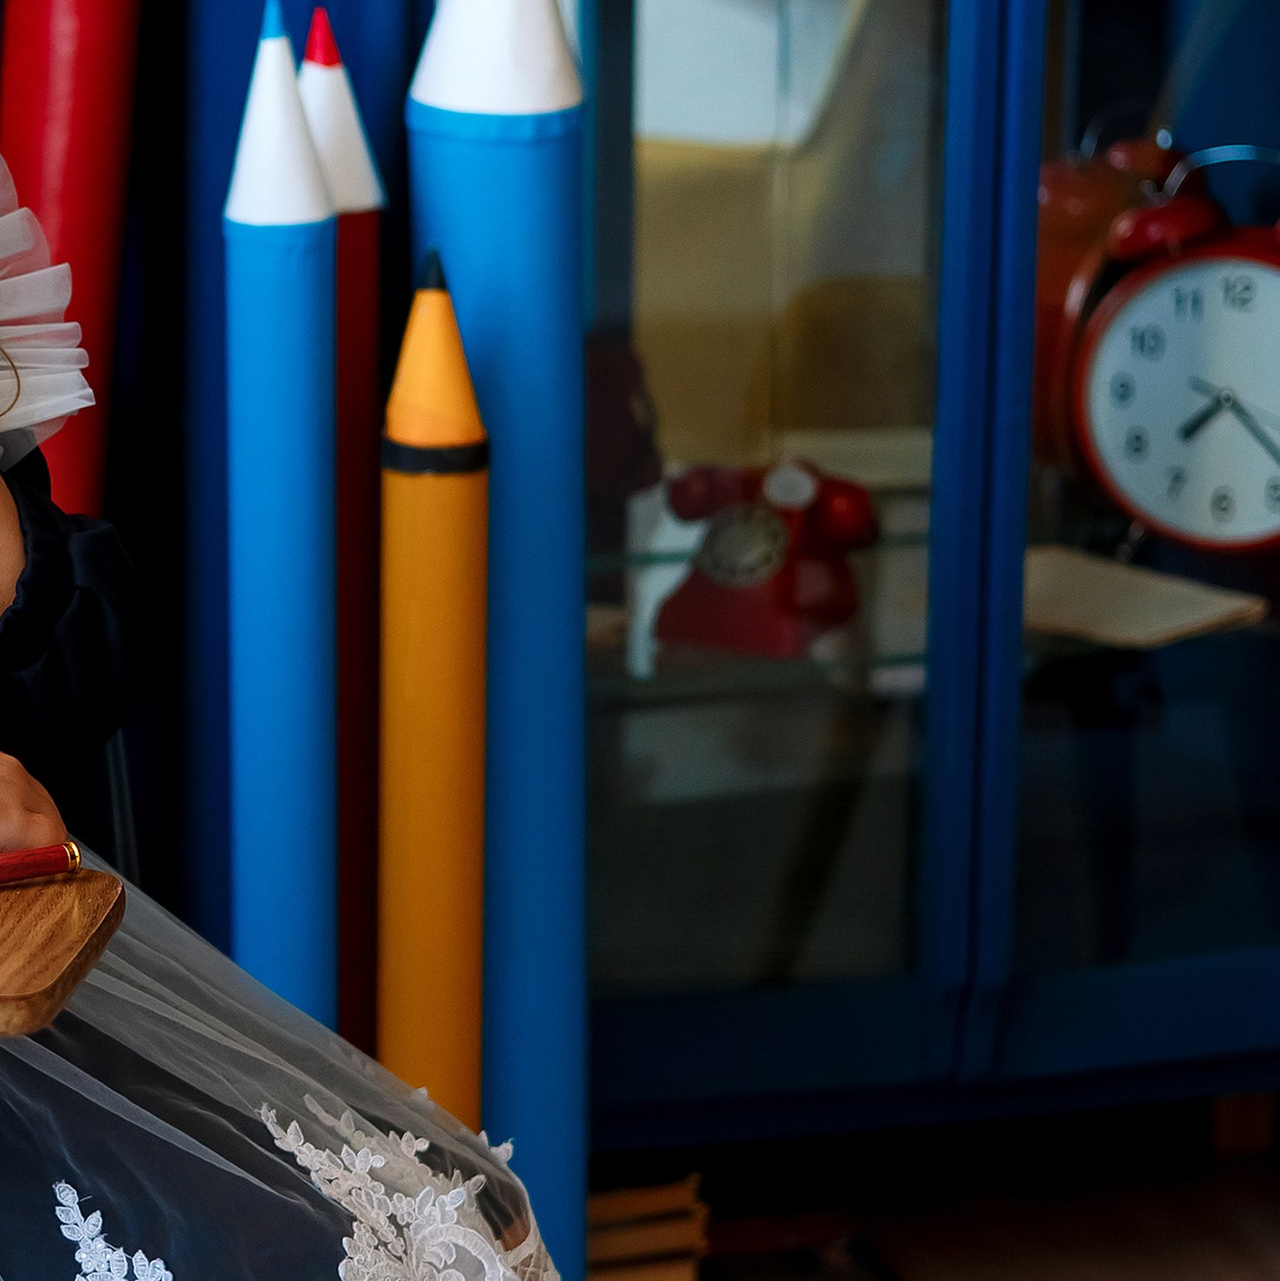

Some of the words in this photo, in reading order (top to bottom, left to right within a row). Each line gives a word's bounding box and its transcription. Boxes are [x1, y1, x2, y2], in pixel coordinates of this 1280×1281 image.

[1173, 285, 1206, 322] 11
[1222, 274, 1258, 312] 12
[1128, 324, 1167, 361] 10
[1109, 373, 1136, 409] 9
[1166, 464, 1190, 503] 7
